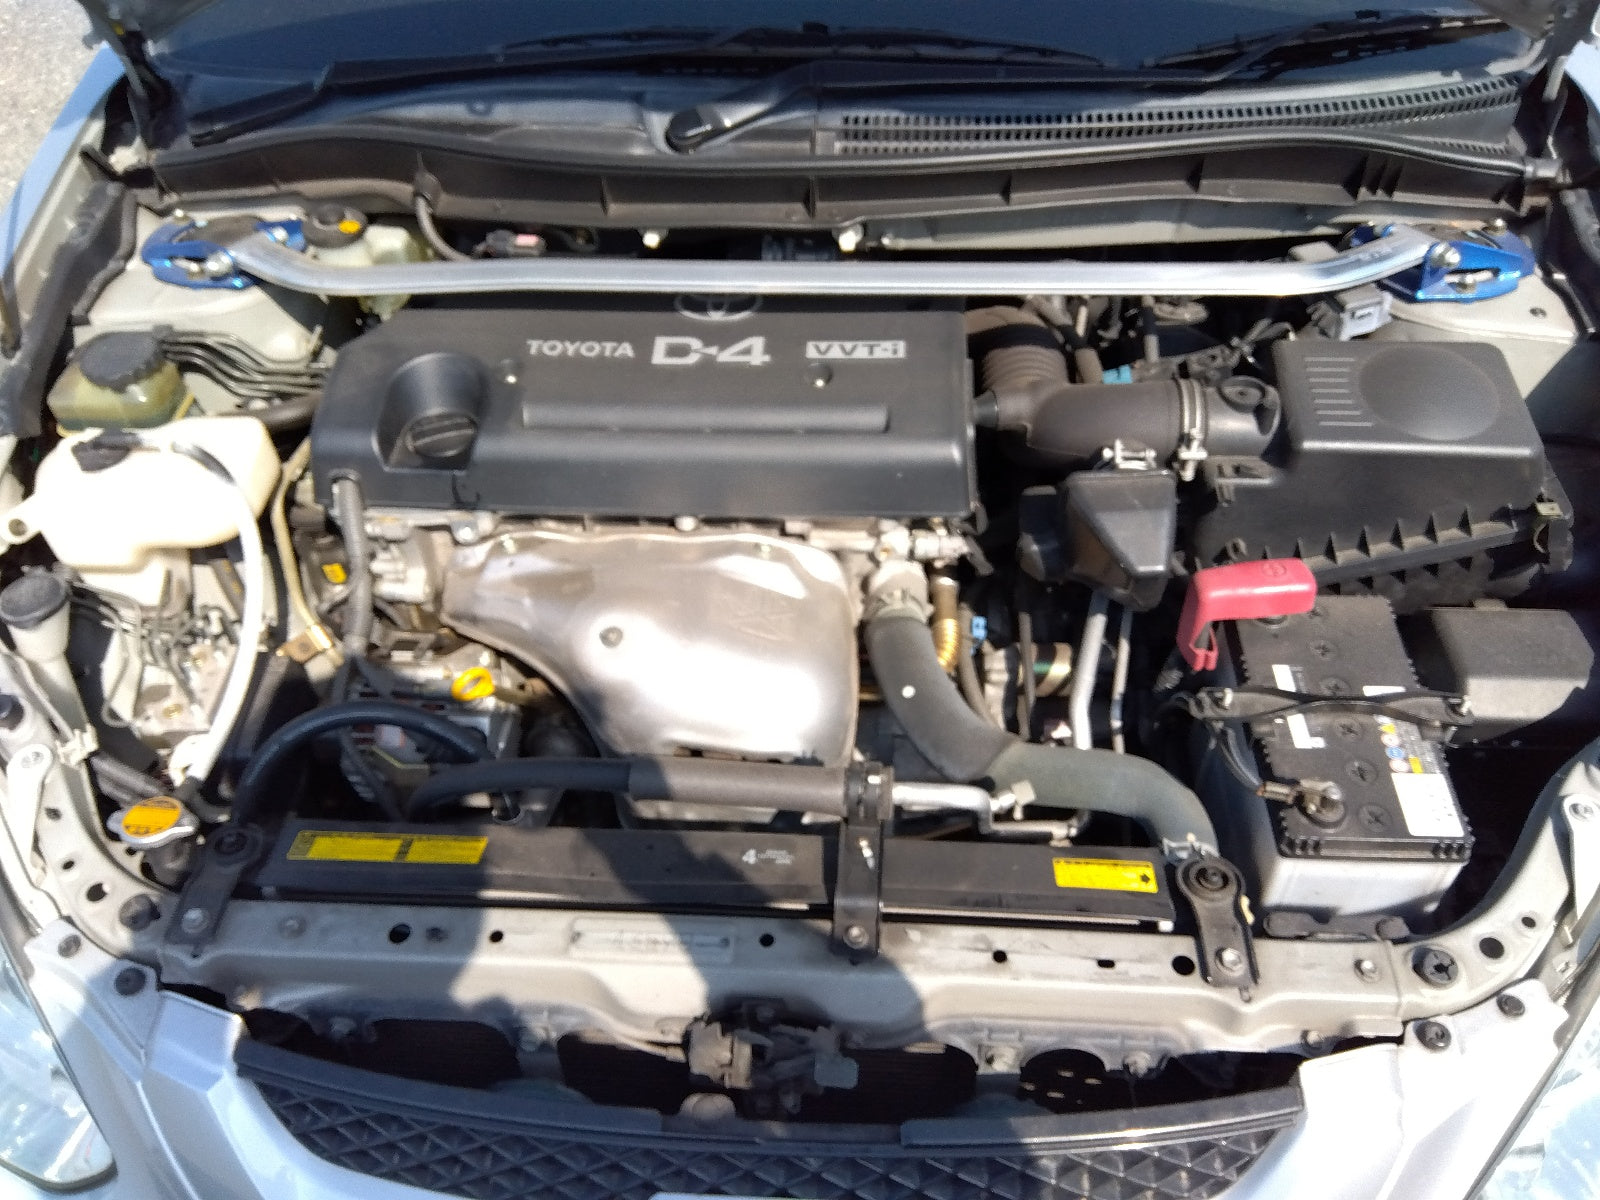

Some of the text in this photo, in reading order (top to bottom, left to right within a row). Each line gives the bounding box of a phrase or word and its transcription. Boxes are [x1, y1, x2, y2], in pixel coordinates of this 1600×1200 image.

[526, 336, 902, 366] TOYOTA D-4 VVT-i
